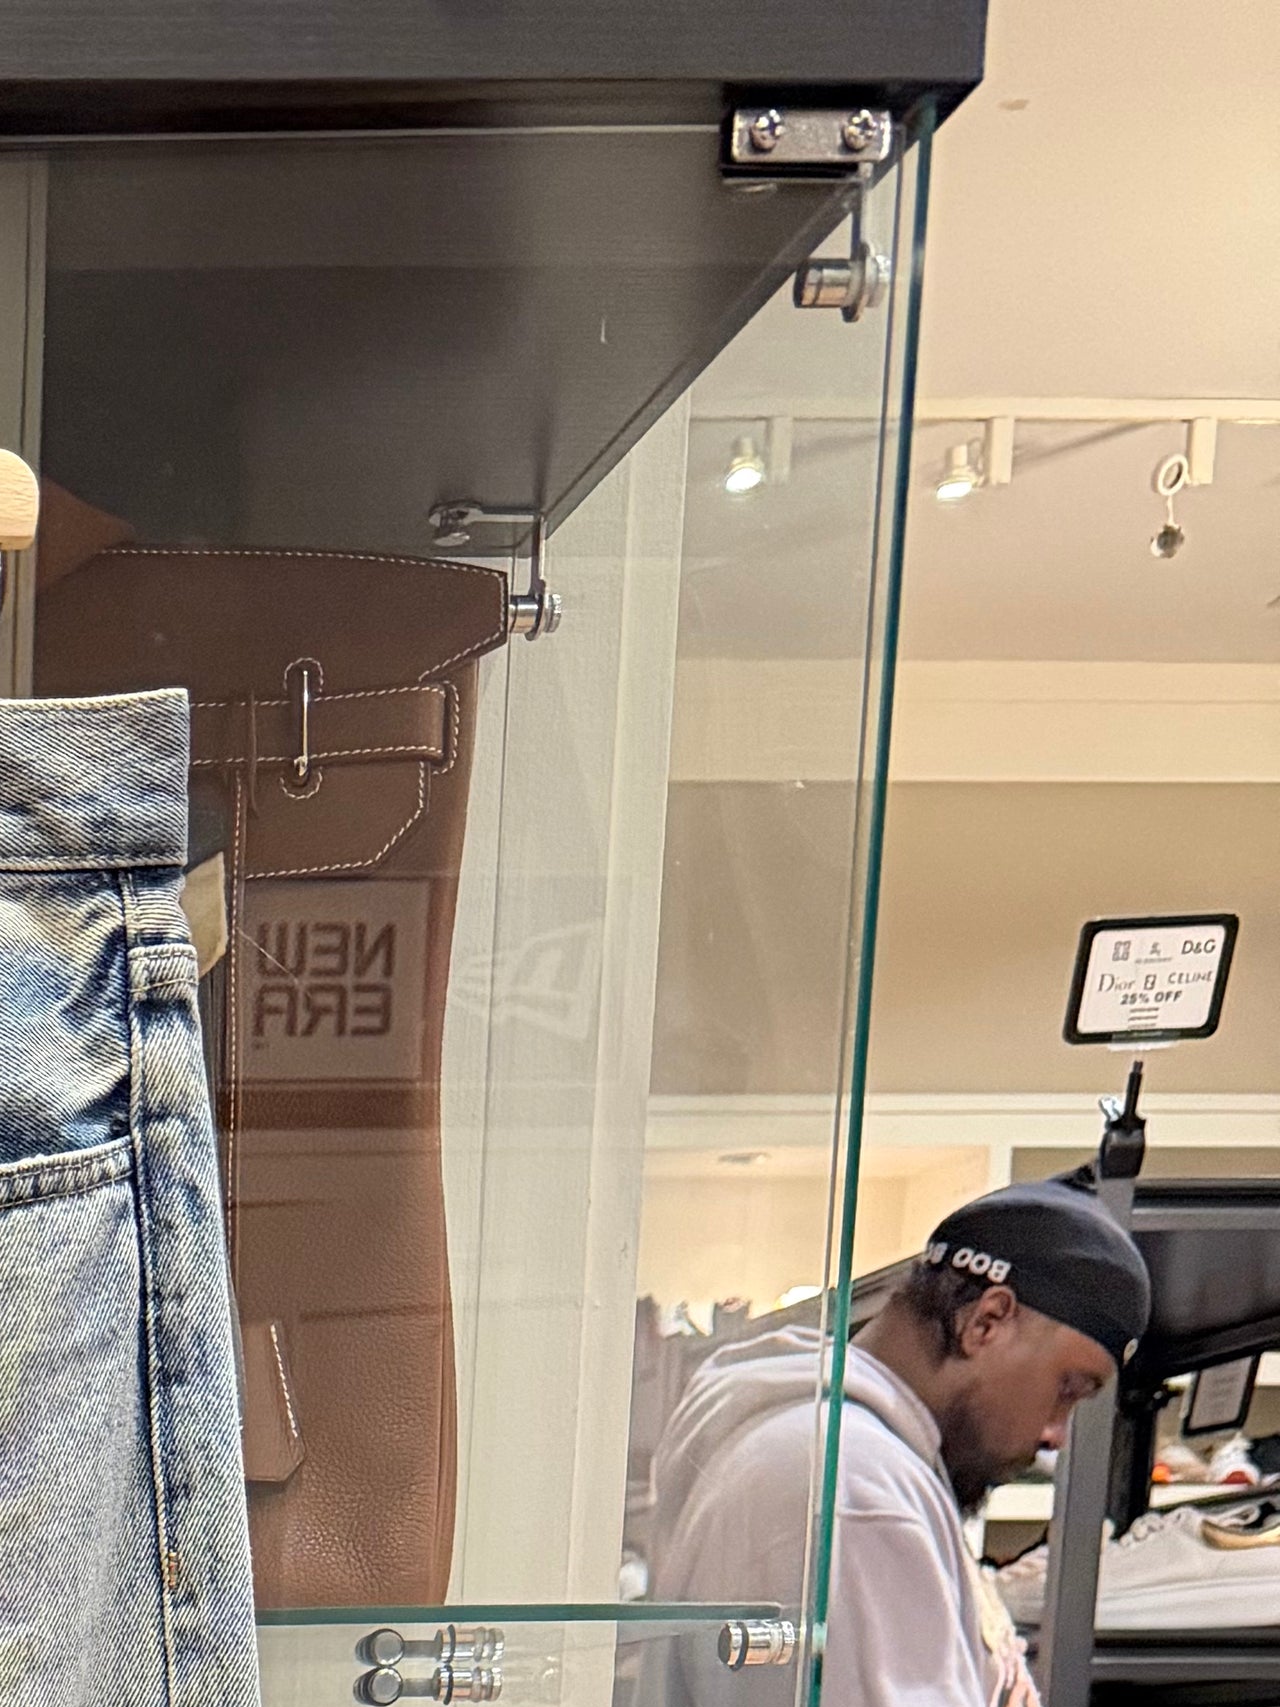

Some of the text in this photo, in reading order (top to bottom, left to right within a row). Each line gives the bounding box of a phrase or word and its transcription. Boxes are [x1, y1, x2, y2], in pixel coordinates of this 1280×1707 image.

[1181, 938, 1216, 955] D&G
[1098, 973, 1136, 992] Dior
[1167, 970, 1213, 985] CELINE
[1154, 990, 1182, 1003] OFF
